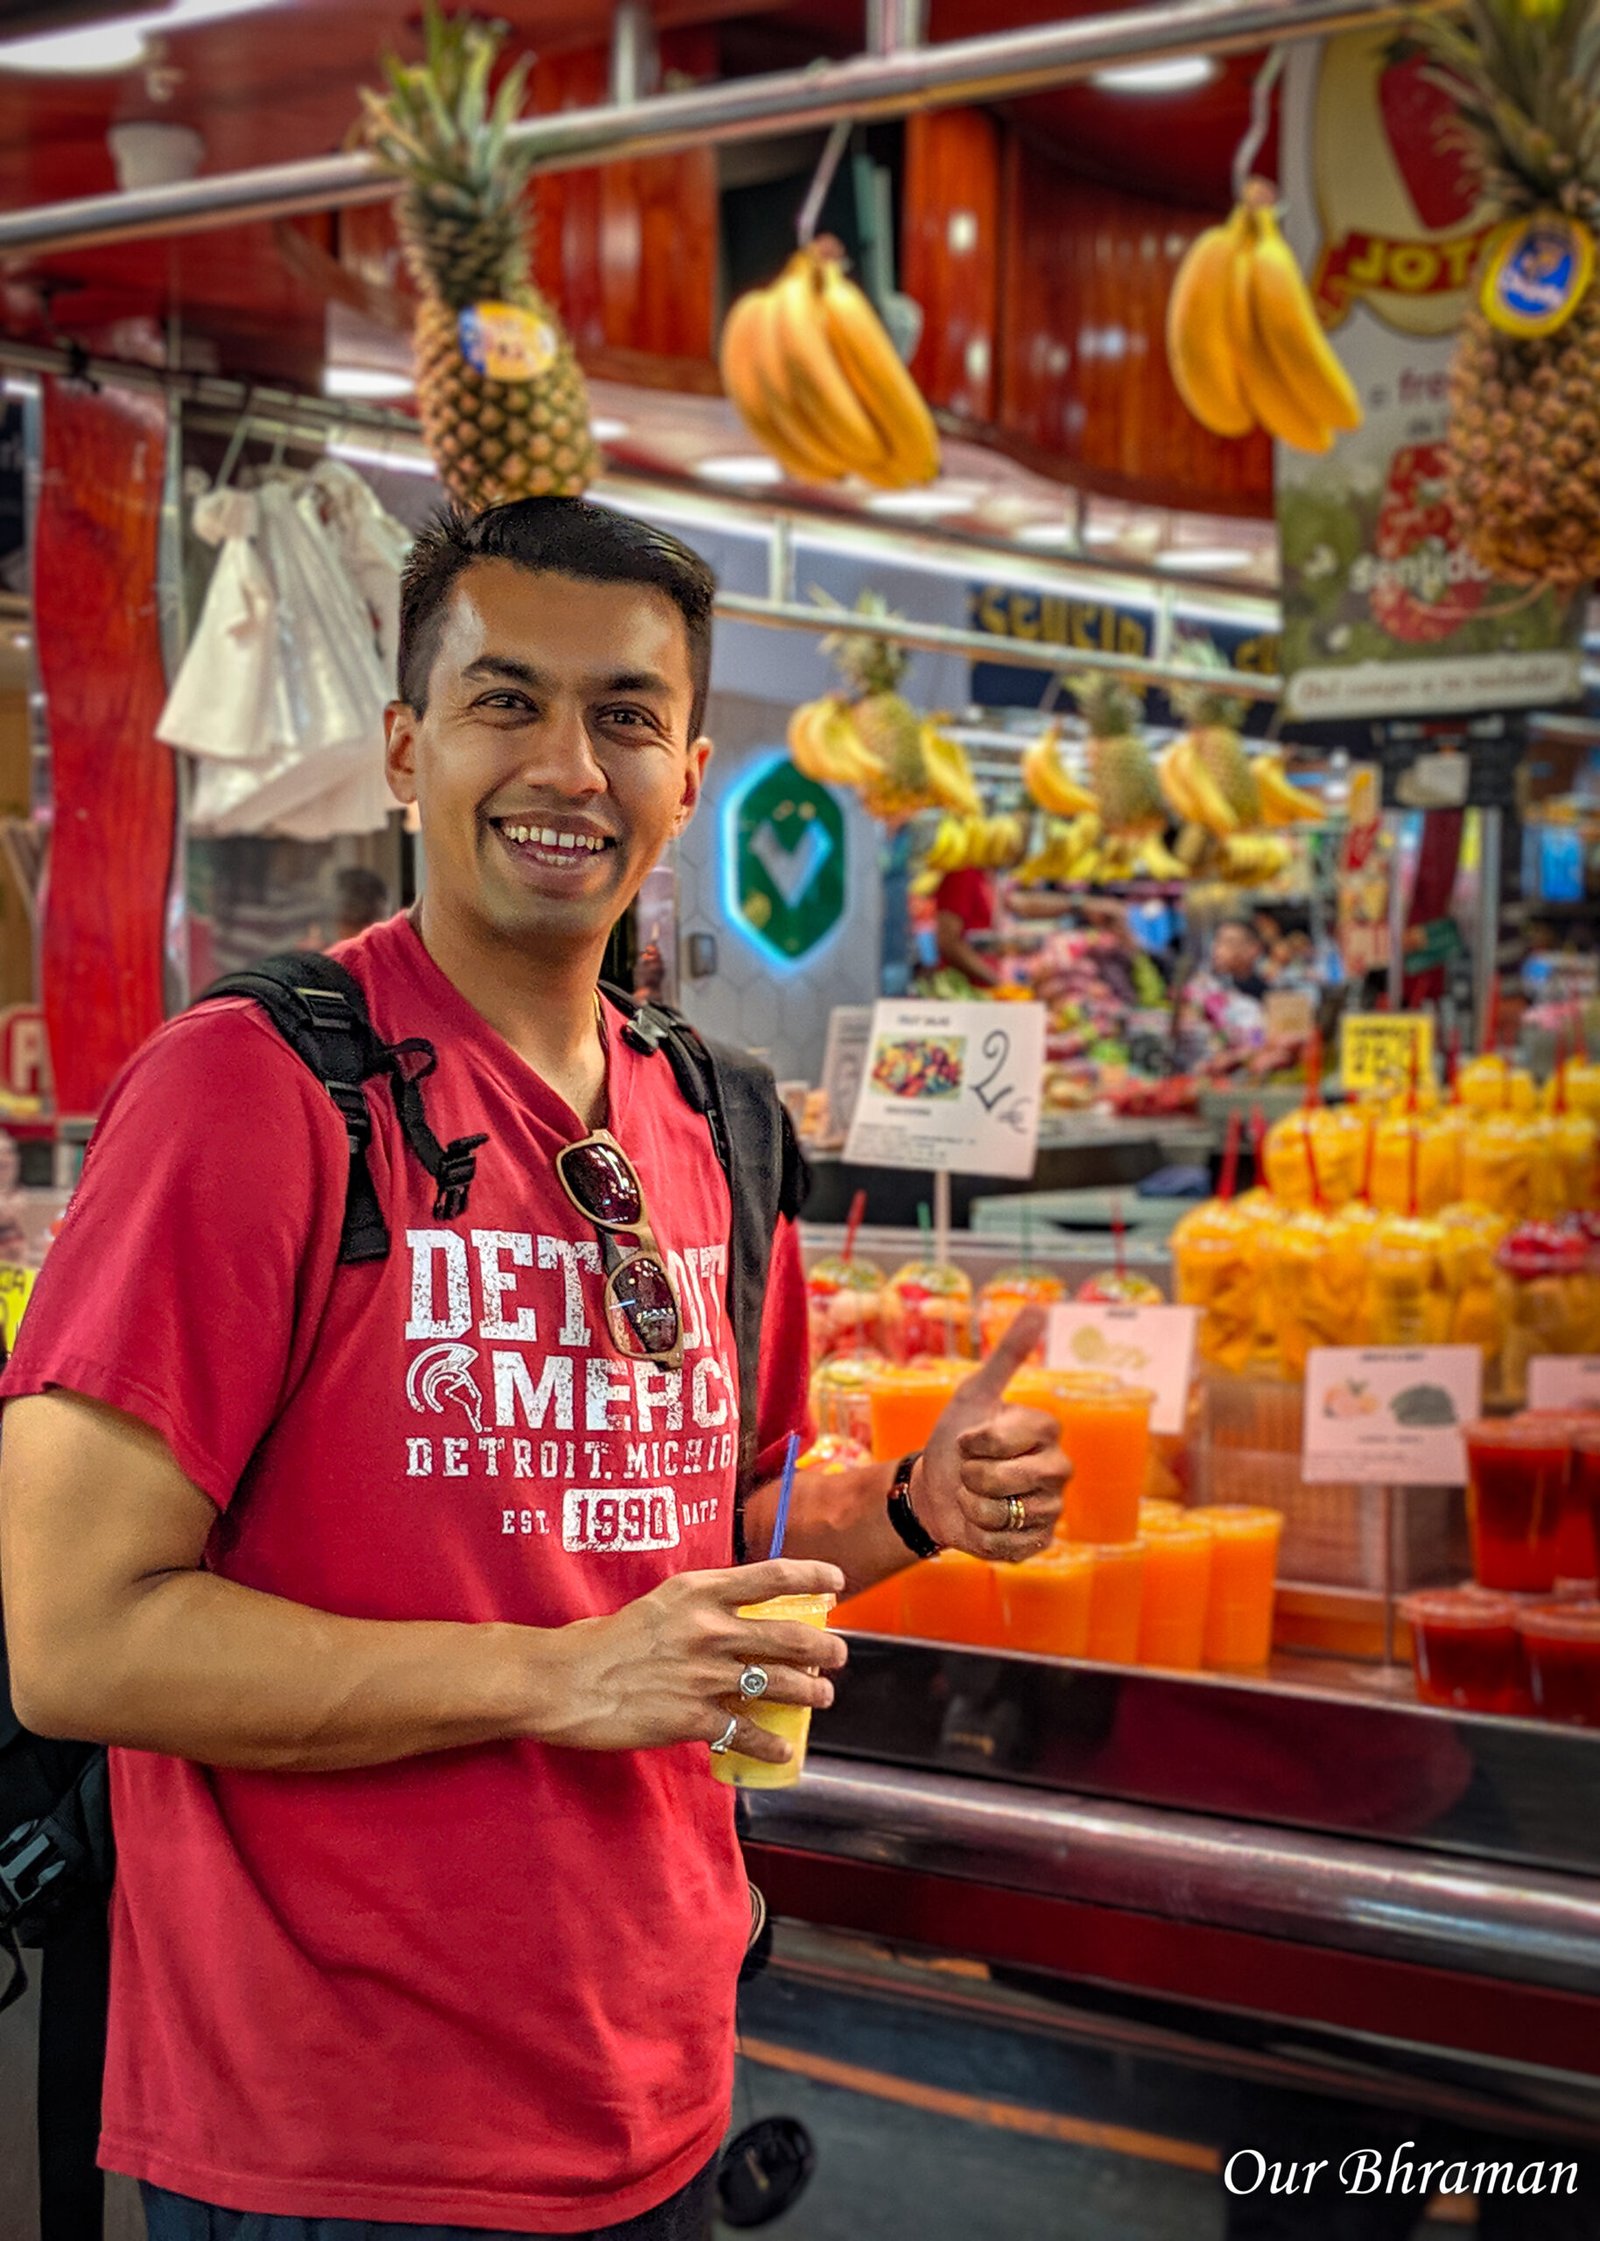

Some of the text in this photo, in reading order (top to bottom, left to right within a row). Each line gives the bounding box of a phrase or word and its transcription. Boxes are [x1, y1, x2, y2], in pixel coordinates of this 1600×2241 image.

[405, 1229, 727, 1348] DETOIT
[576, 1499, 670, 1543] 1990
[682, 1498, 719, 1526] DATE
